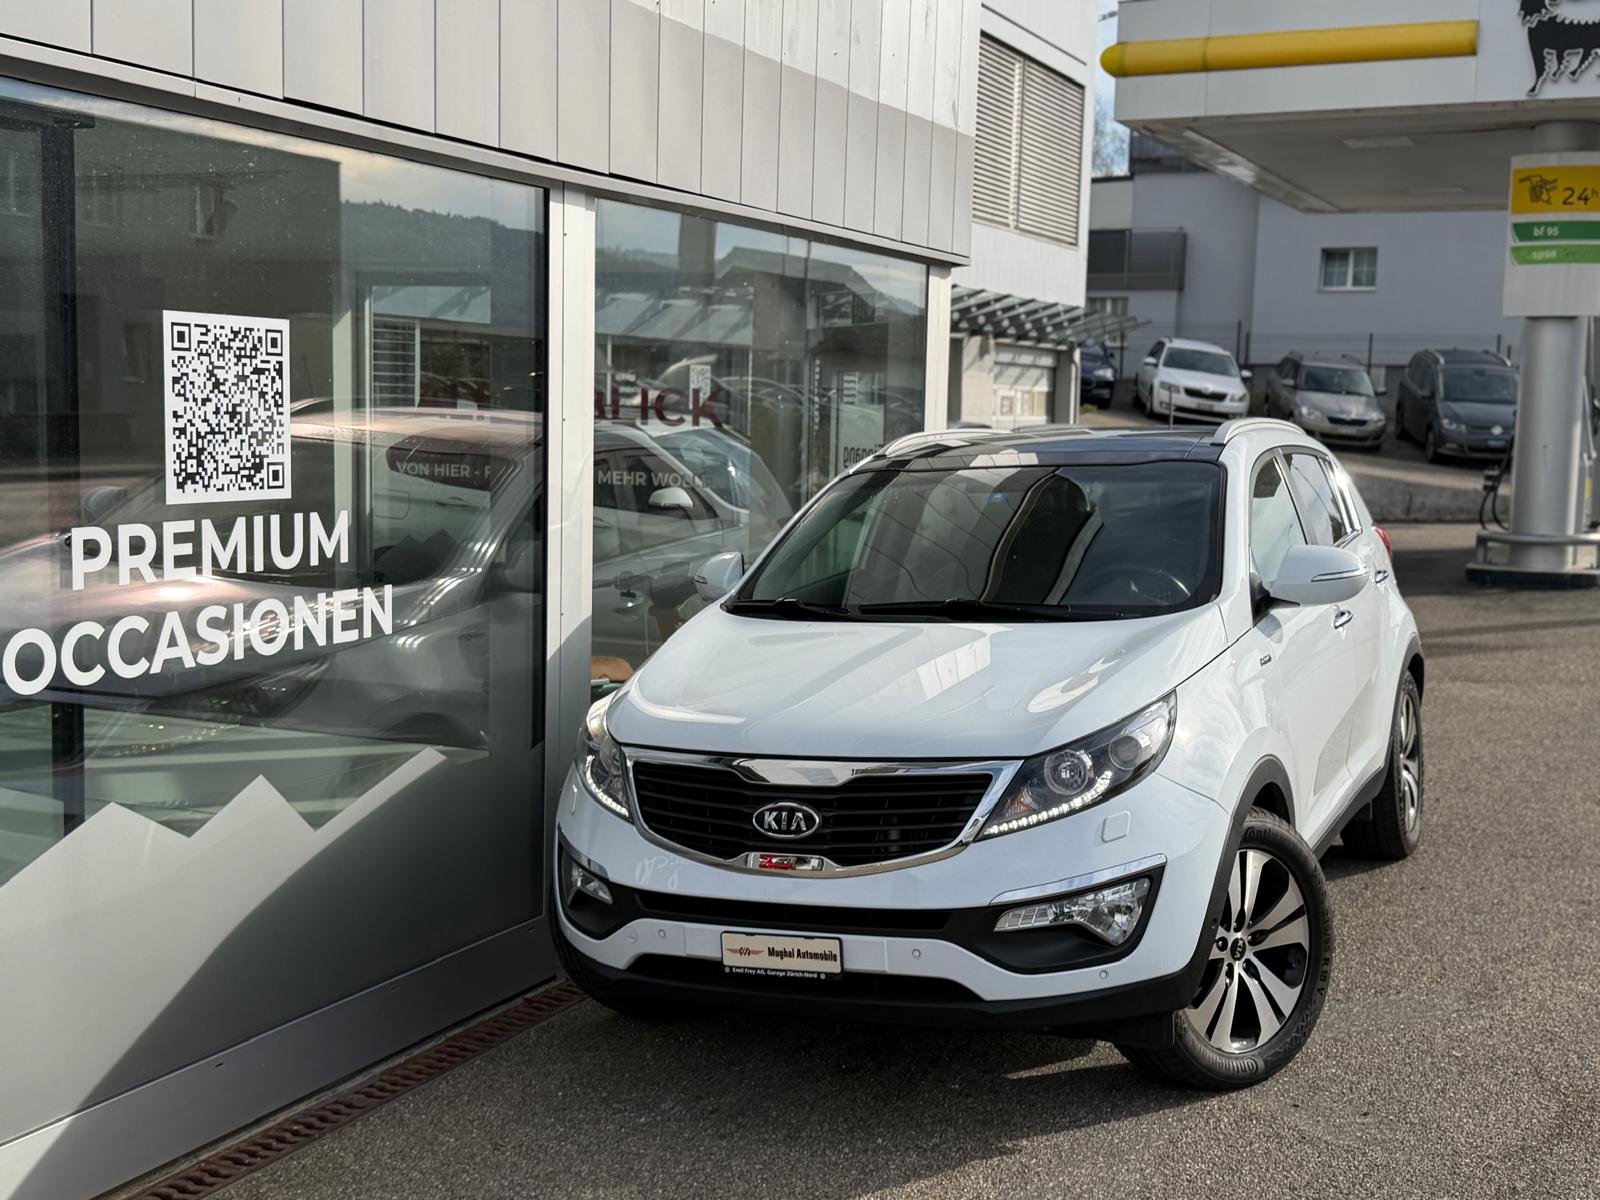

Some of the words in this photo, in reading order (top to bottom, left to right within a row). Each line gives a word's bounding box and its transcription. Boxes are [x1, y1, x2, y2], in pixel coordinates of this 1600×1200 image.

[1546, 226, 1559, 237] 95
[397, 462, 429, 476] VON
[434, 464, 470, 478] HIER
[597, 470, 648, 486] MEHR
[71, 510, 349, 591] PREMIUM
[2, 584, 393, 696] OCCASIONEN
[763, 811, 807, 831] KIA
[767, 947, 794, 960] Mughal
[796, 948, 838, 962] Automobile
